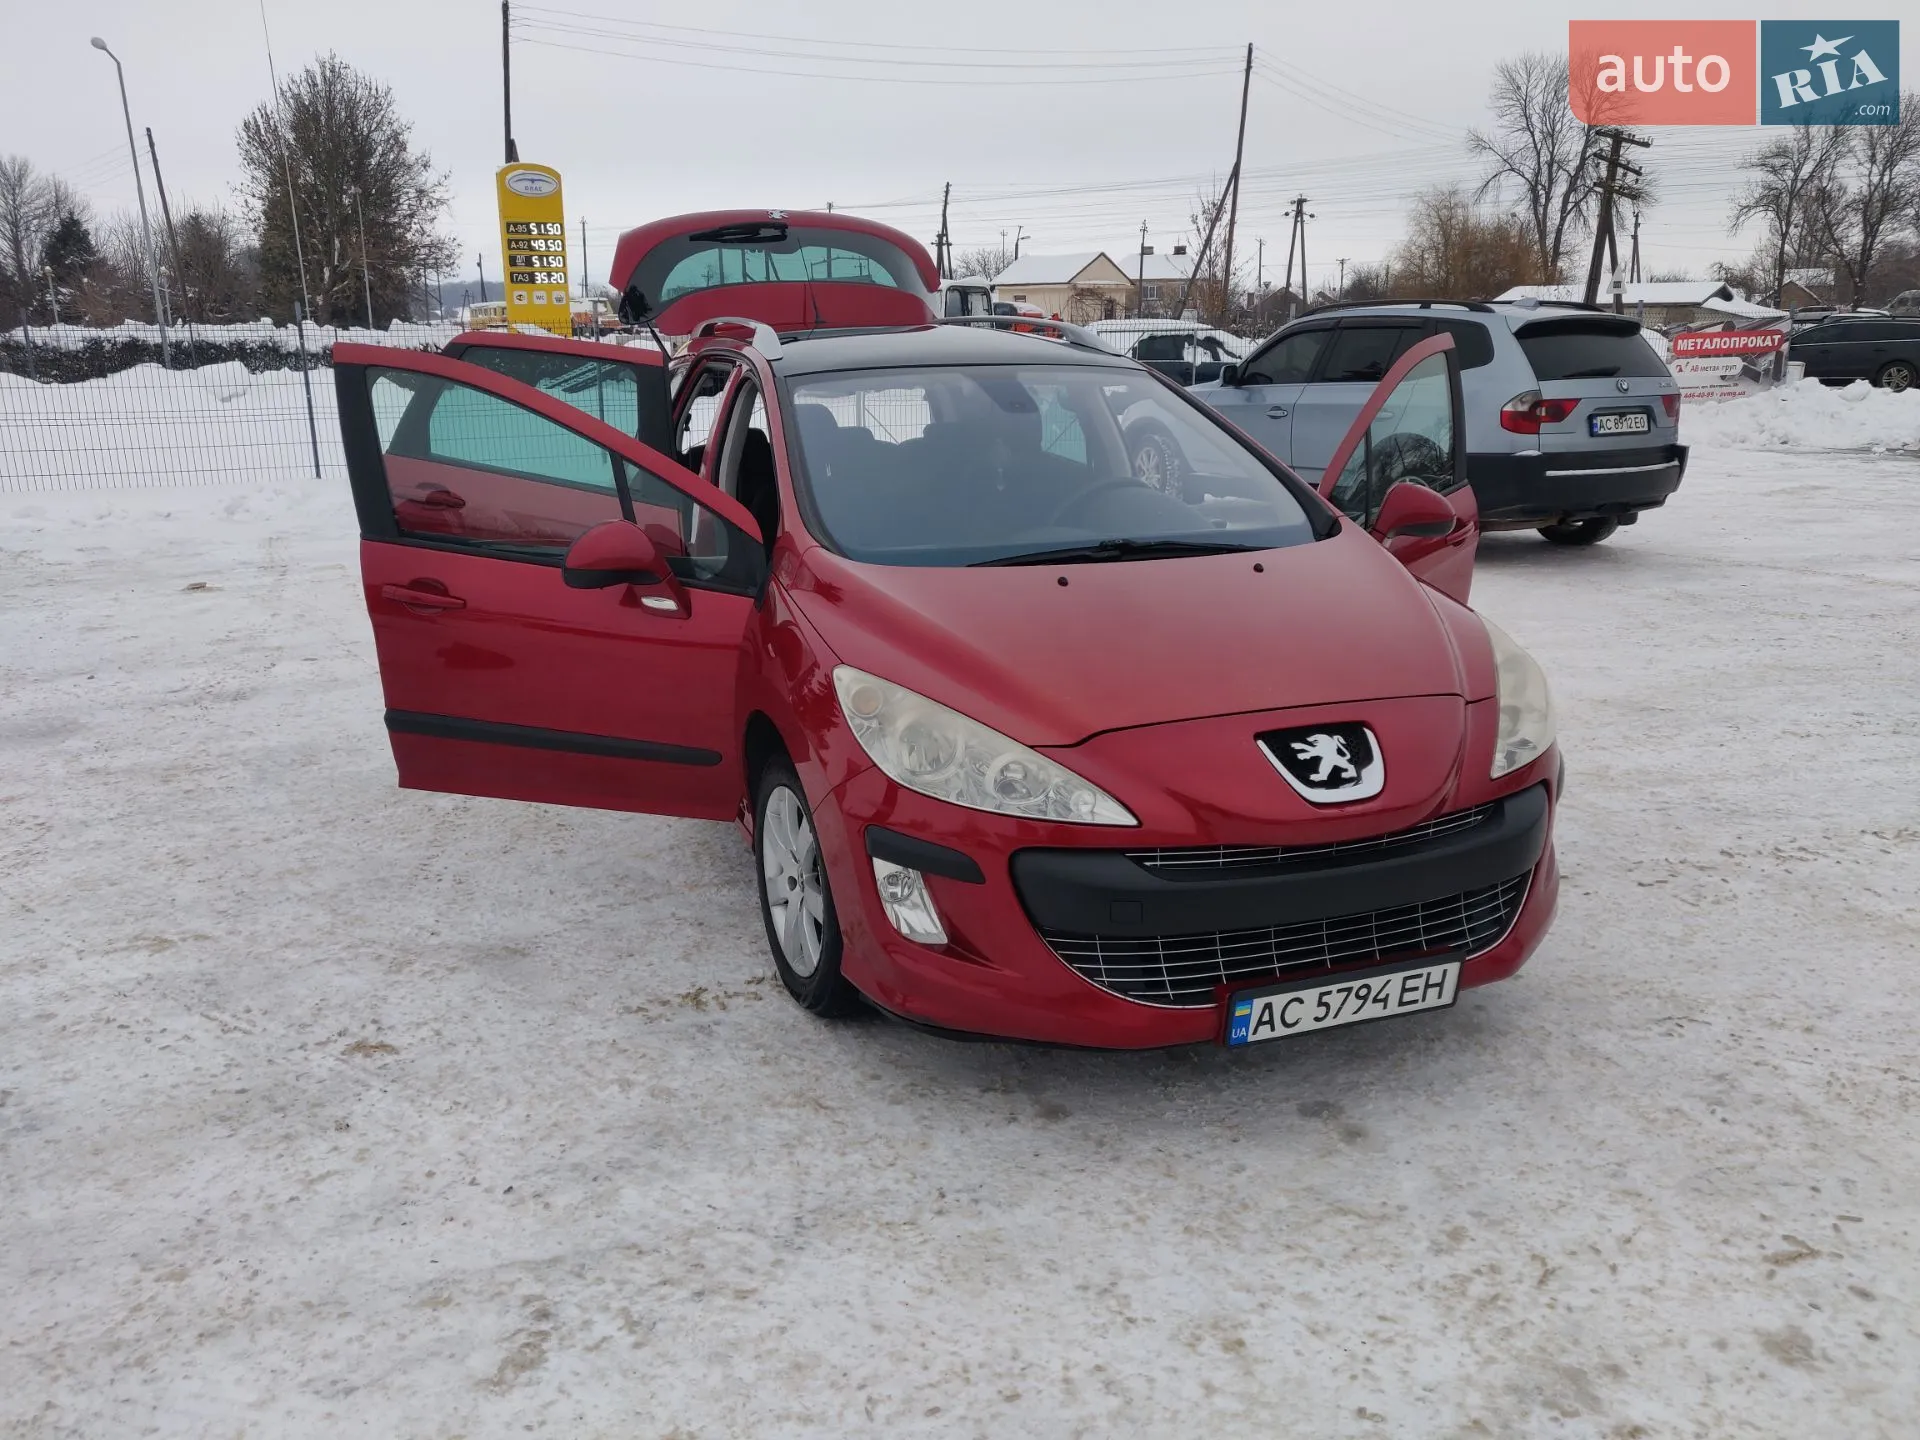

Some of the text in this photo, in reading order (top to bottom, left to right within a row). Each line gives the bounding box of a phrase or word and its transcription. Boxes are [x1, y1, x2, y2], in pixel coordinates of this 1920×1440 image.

[530, 222, 561, 235] 51.50
[531, 239, 562, 251] 49.50
[532, 255, 563, 267] 51.50
[513, 272, 565, 284] ГАЗ 35.20
[1677, 334, 1781, 351] МЕТАЛОПРОКАТ
[1599, 418, 1613, 431] AC
[1252, 969, 1448, 1036] AC 5794 EH
[1232, 1028, 1247, 1039] UA
